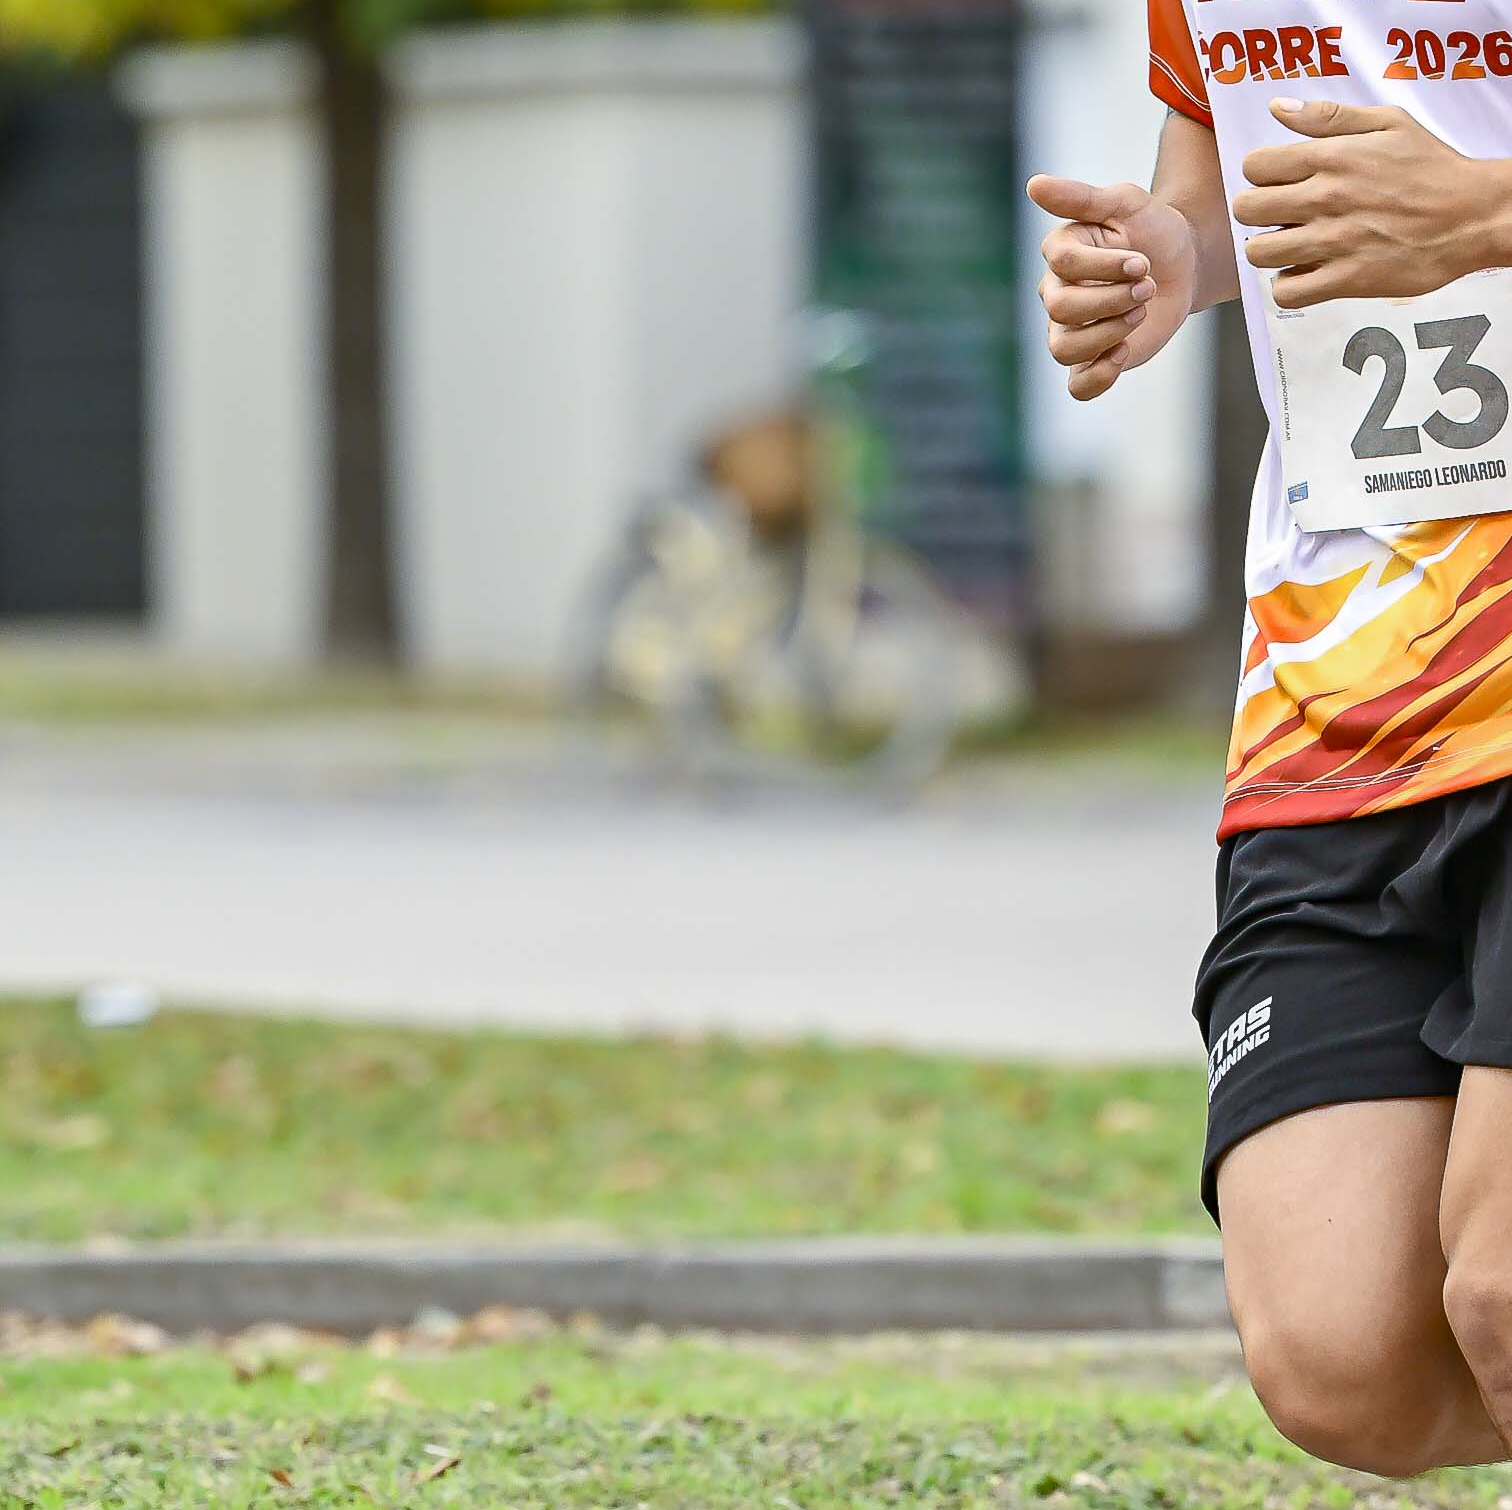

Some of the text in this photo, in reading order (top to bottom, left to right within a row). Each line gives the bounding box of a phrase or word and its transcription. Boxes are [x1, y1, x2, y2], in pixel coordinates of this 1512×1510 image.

[1342, 313, 1509, 459] 23
[1364, 459, 1507, 494] SAMANIEGO LEONARDO
[1208, 1024, 1271, 1103] UNNING
